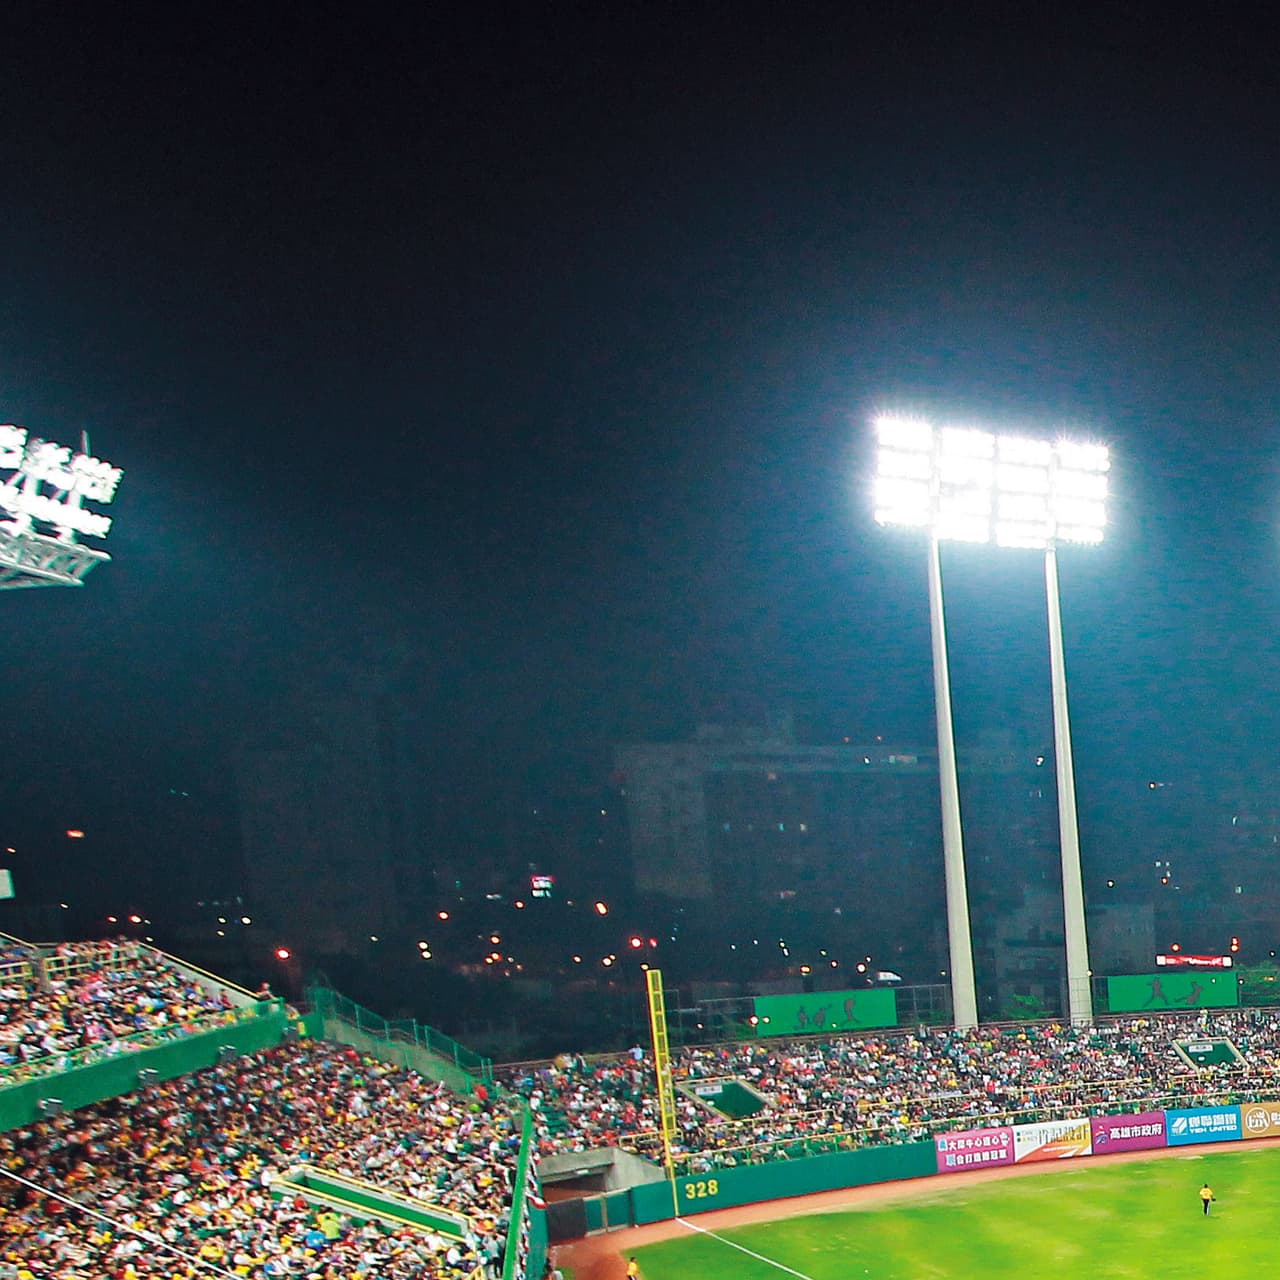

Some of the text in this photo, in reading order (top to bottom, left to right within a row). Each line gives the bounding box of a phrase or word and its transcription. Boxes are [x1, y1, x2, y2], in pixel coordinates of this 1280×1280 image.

[1110, 1123, 1163, 1140] 高雄市政府
[1209, 1125, 1237, 1133] UNITED
[686, 1180, 718, 1200] 328
